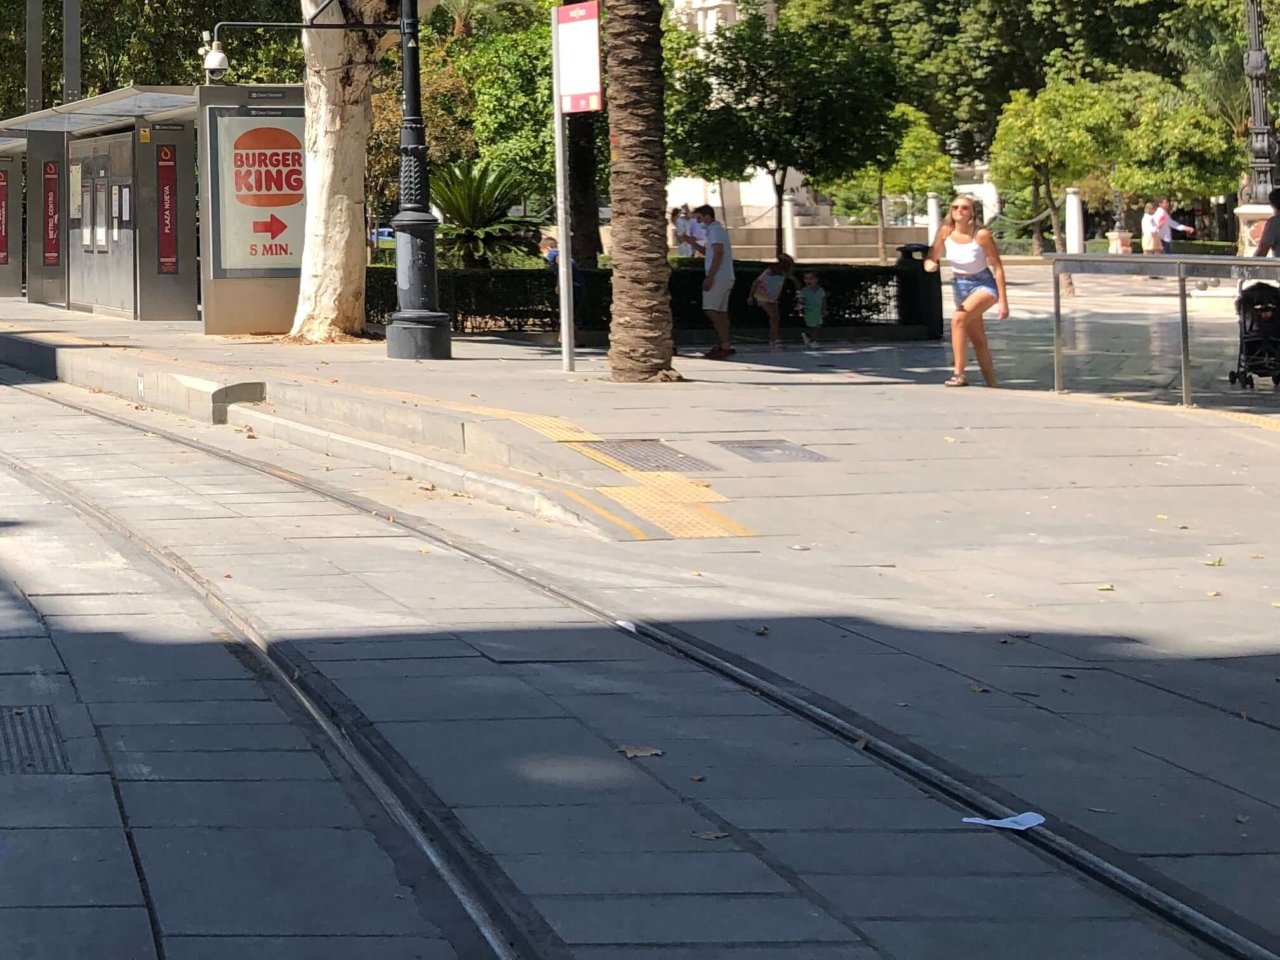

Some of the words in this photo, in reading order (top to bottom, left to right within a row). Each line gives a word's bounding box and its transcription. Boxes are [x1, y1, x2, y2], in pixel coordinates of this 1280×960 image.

[233, 151, 303, 169] BURGER
[234, 168, 304, 192] KING
[249, 243, 258, 256] 5
[261, 243, 293, 256] MIN.
